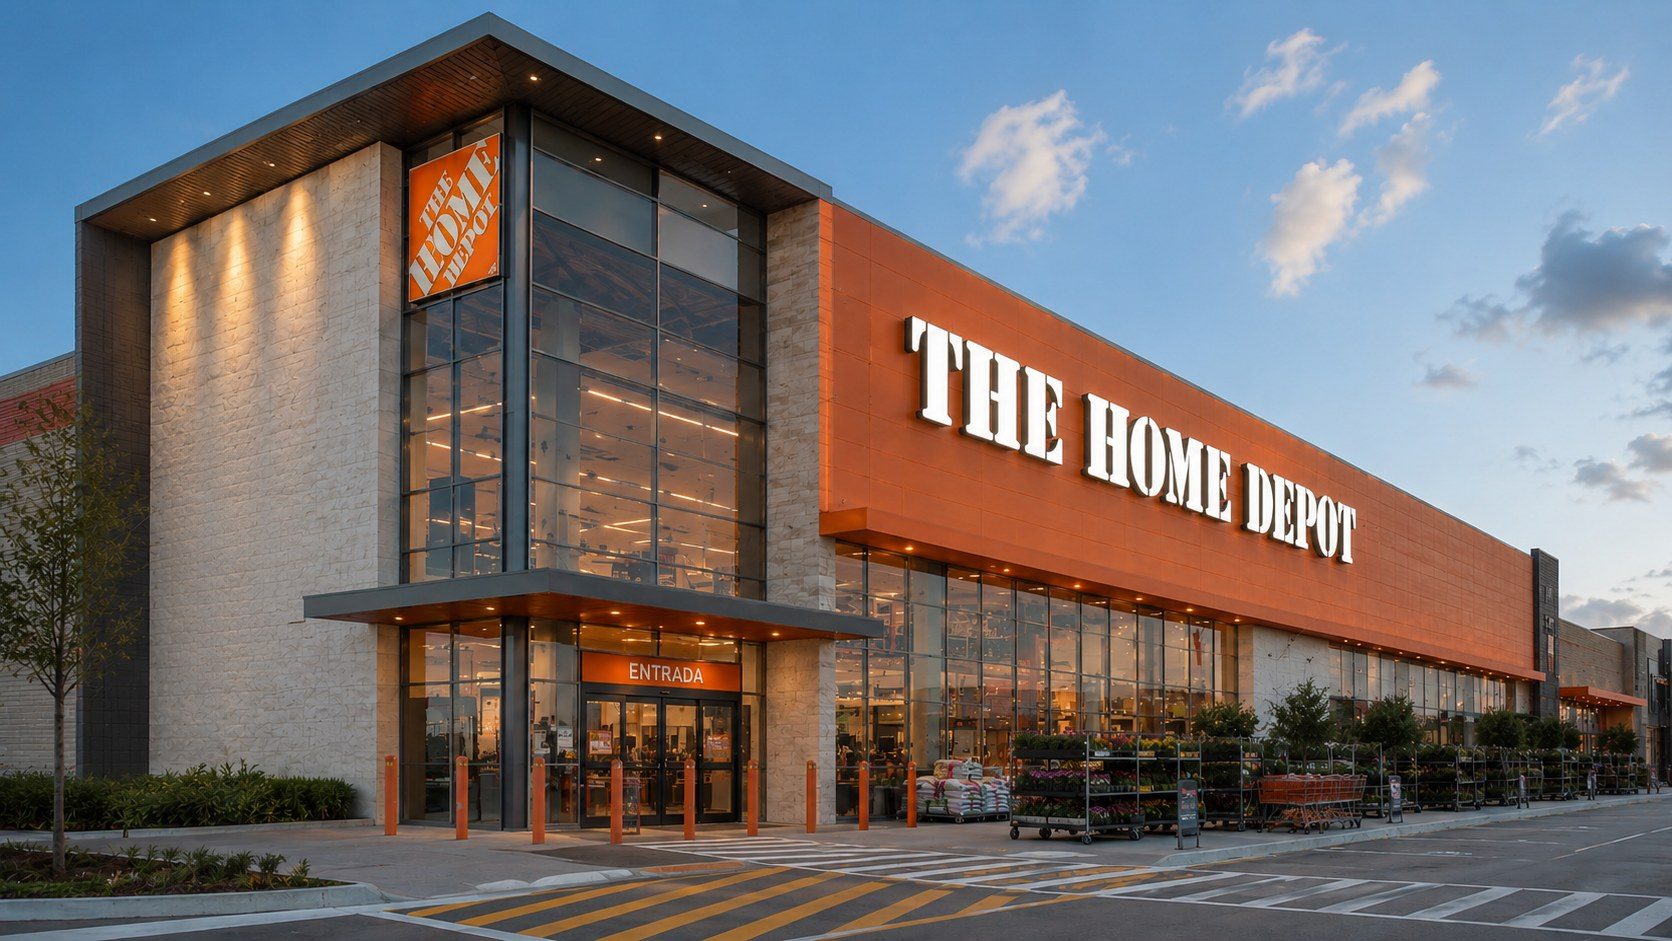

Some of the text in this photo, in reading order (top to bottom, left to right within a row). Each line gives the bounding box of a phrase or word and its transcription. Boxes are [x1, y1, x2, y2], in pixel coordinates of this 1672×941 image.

[410, 140, 499, 296] HOME
[420, 171, 453, 230] THE
[444, 193, 498, 287] DEPOT
[905, 316, 1357, 564] THE HOME DEPOT
[630, 663, 704, 684] ENTRADA
